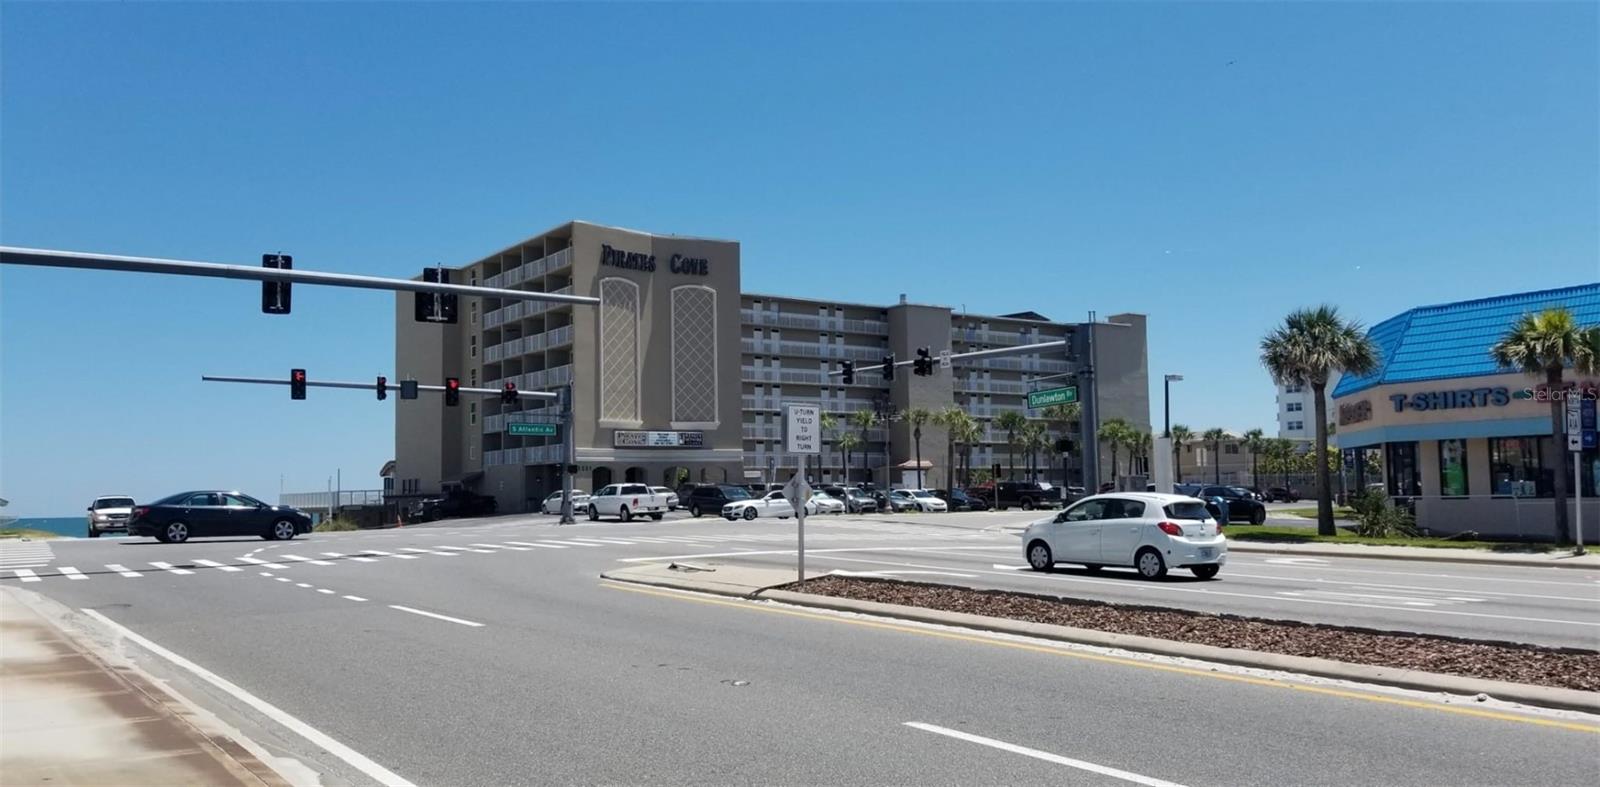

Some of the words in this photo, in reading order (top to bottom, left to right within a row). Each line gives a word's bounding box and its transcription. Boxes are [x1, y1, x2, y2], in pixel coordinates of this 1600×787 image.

[601, 244, 656, 272] PIRATES
[670, 254, 709, 275] COVE
[1031, 393, 1066, 405] Dunlawton
[1389, 387, 1510, 412] T-SHIRTS
